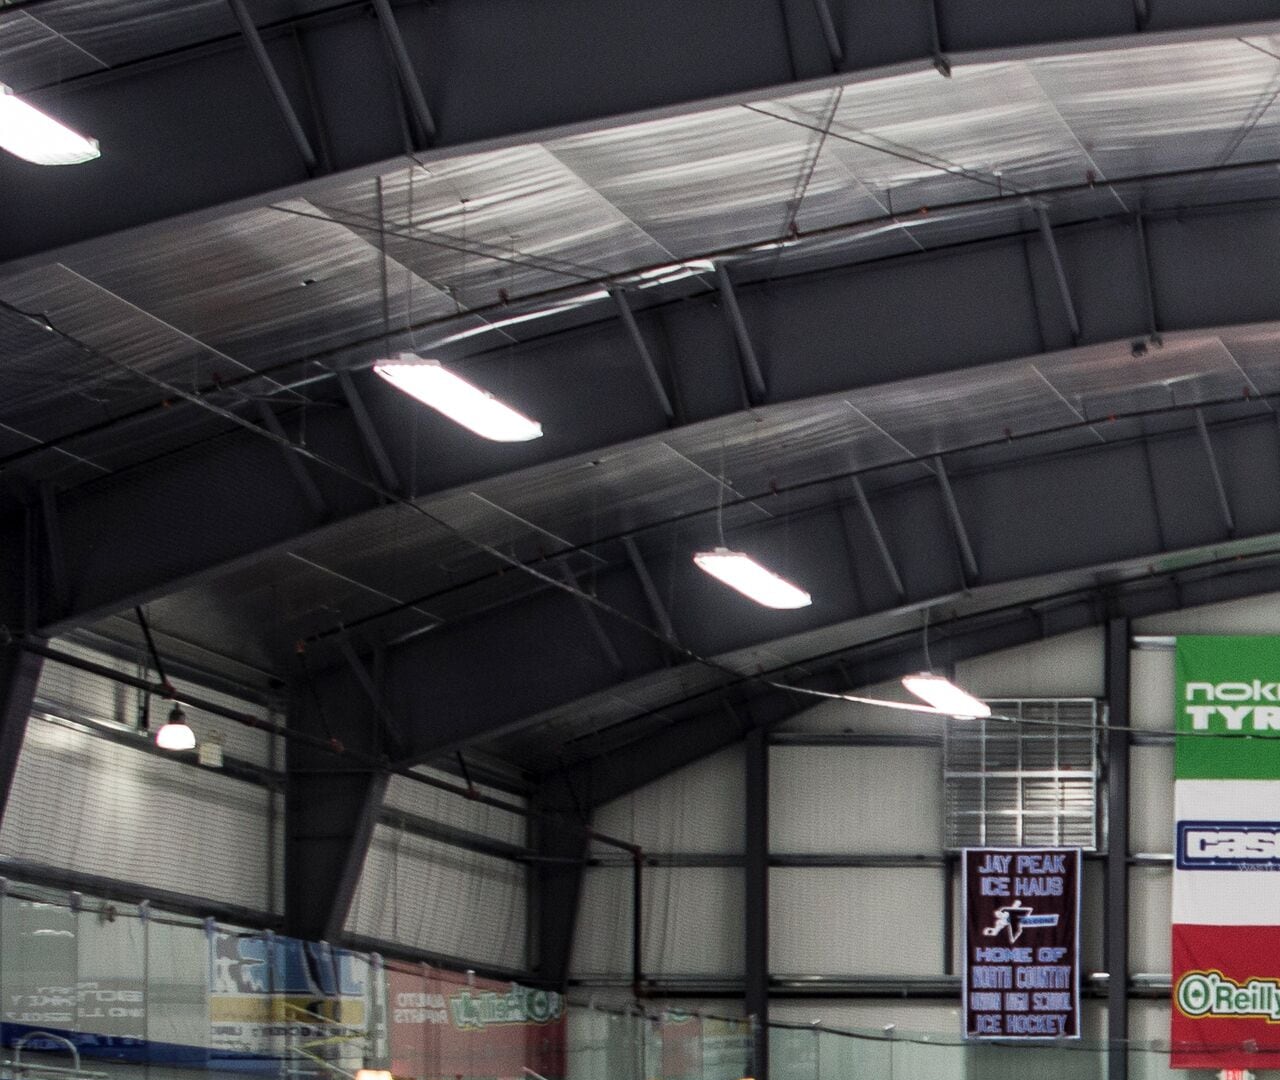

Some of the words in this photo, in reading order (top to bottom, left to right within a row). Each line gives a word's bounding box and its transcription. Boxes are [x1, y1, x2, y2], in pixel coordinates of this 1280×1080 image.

[977, 855, 1012, 873] JAY
[1017, 855, 1066, 874] PEAK
[981, 877, 1010, 896] ICE
[975, 947, 1033, 962] HOME
[1038, 947, 1068, 962] OF
[973, 966, 1012, 988] NORTH
[1016, 966, 1071, 989] COUNTRY
[976, 1015, 1002, 1033] ICE
[1006, 1015, 1067, 1033] HOCKEY
